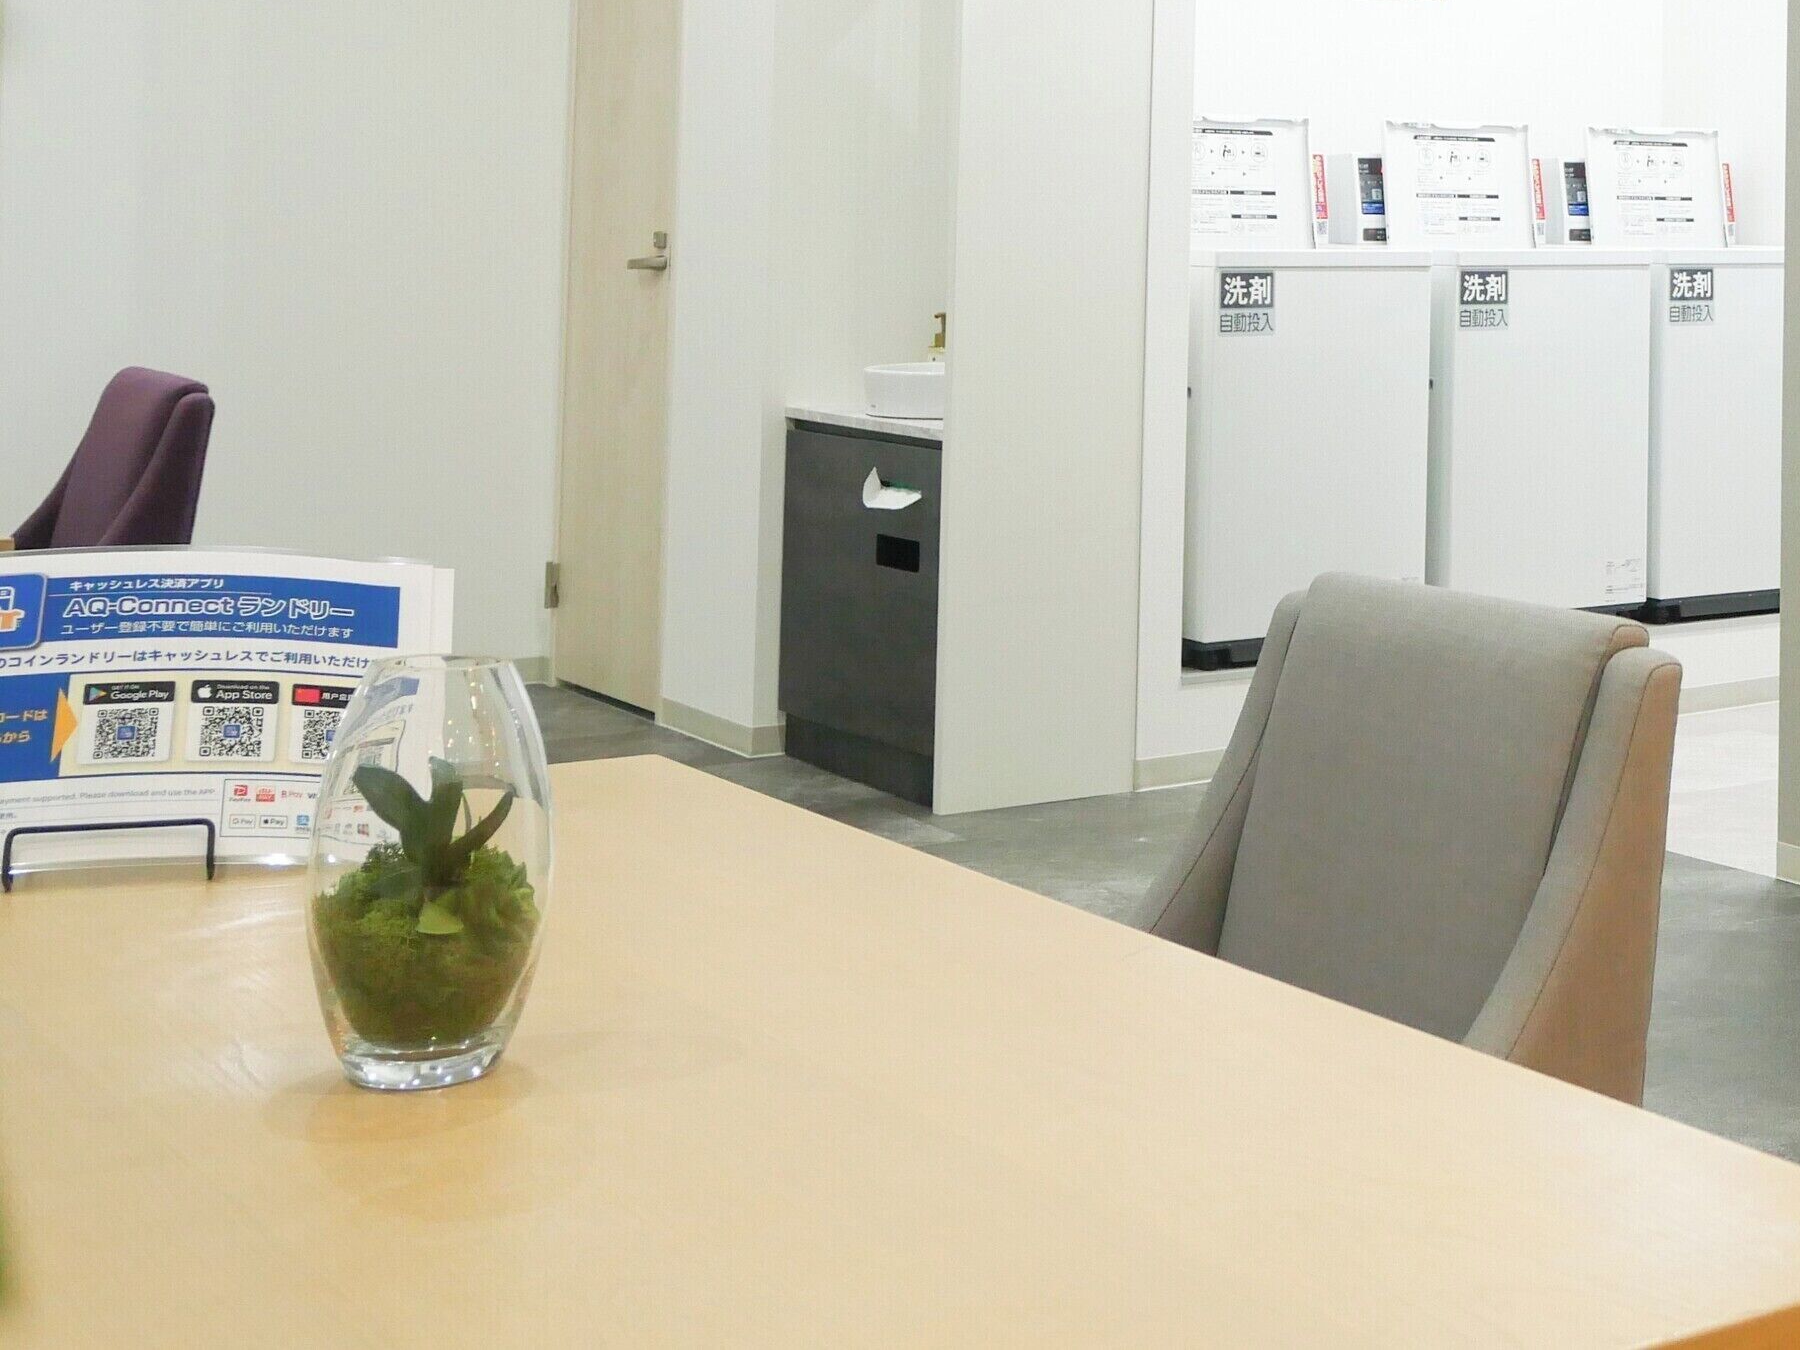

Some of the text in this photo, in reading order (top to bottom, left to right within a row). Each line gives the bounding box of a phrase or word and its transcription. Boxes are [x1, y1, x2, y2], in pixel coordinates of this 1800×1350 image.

[1223, 275, 1272, 306] 洗剤
[1462, 274, 1506, 302] 洗剤
[1672, 271, 1713, 298] 洗剤
[1219, 312, 1274, 334] 自動投入
[1459, 308, 1509, 328] 自動投入
[1668, 305, 1714, 323] 自動投入
[69, 578, 225, 592] キャッシュレス決済アプリ
[63, 596, 355, 620] AQ-Connect ランドリー
[60, 620, 354, 639] ユーザー登録不要で簡単にご利用いただけます
[0, 650, 373, 669] のコインランドリーはキャッシュレスでご利用いただけ
[110, 689, 170, 701] Google Play
[215, 690, 273, 700] App Store
[0, 730, 31, 743] から
